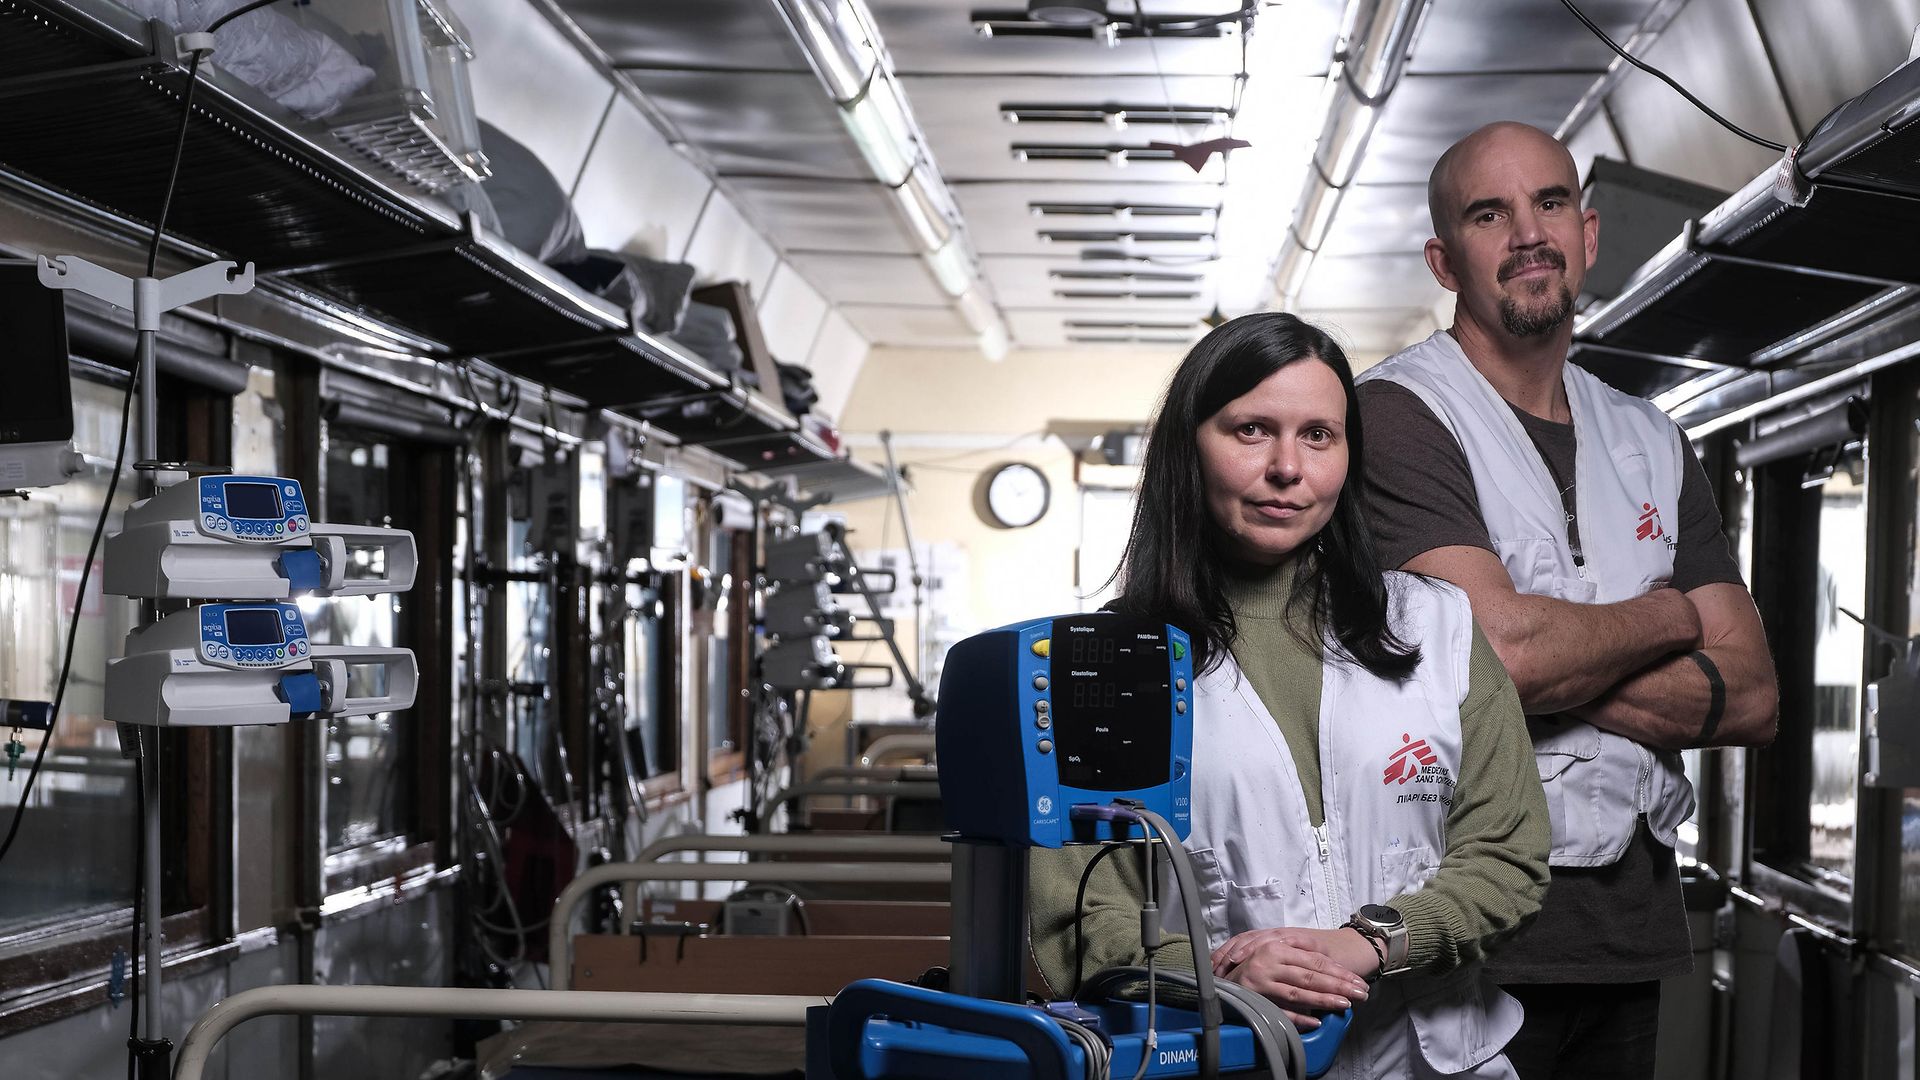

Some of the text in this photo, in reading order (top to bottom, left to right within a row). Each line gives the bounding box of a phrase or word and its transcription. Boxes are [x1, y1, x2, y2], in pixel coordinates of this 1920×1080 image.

[1415, 775, 1434, 783] SANS
[1175, 797, 1189, 807] V100
[1421, 794, 1437, 802] БЕЗ
[1160, 1049, 1199, 1064] DINAMA
